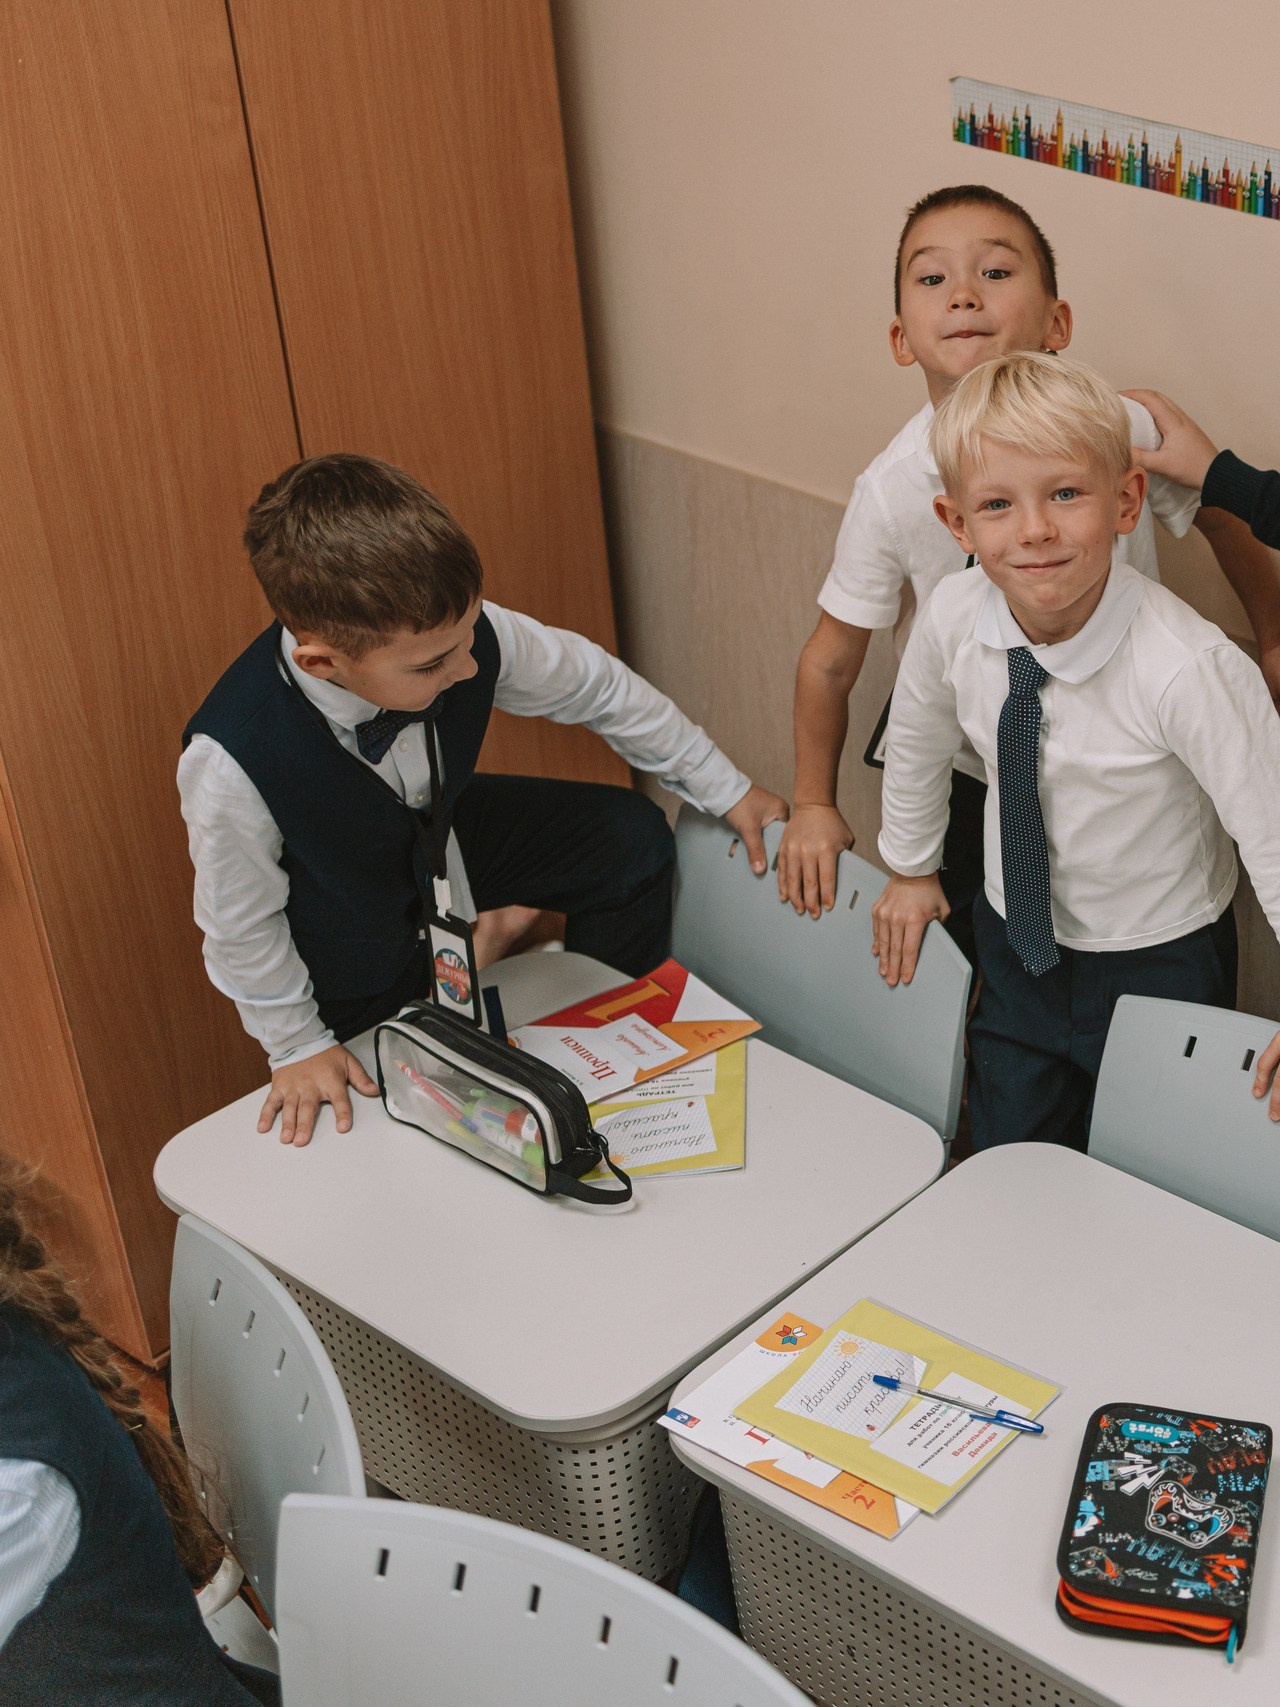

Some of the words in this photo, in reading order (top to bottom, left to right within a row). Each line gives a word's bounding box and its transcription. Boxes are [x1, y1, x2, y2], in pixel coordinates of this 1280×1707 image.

[559, 1035, 619, 1081] Прописи
[800, 1360, 852, 1413] Начинаю
[909, 1403, 942, 1432] ТЕТРАДЬ
[968, 1431, 998, 1458] Демида
[853, 1494, 876, 1510] 2
